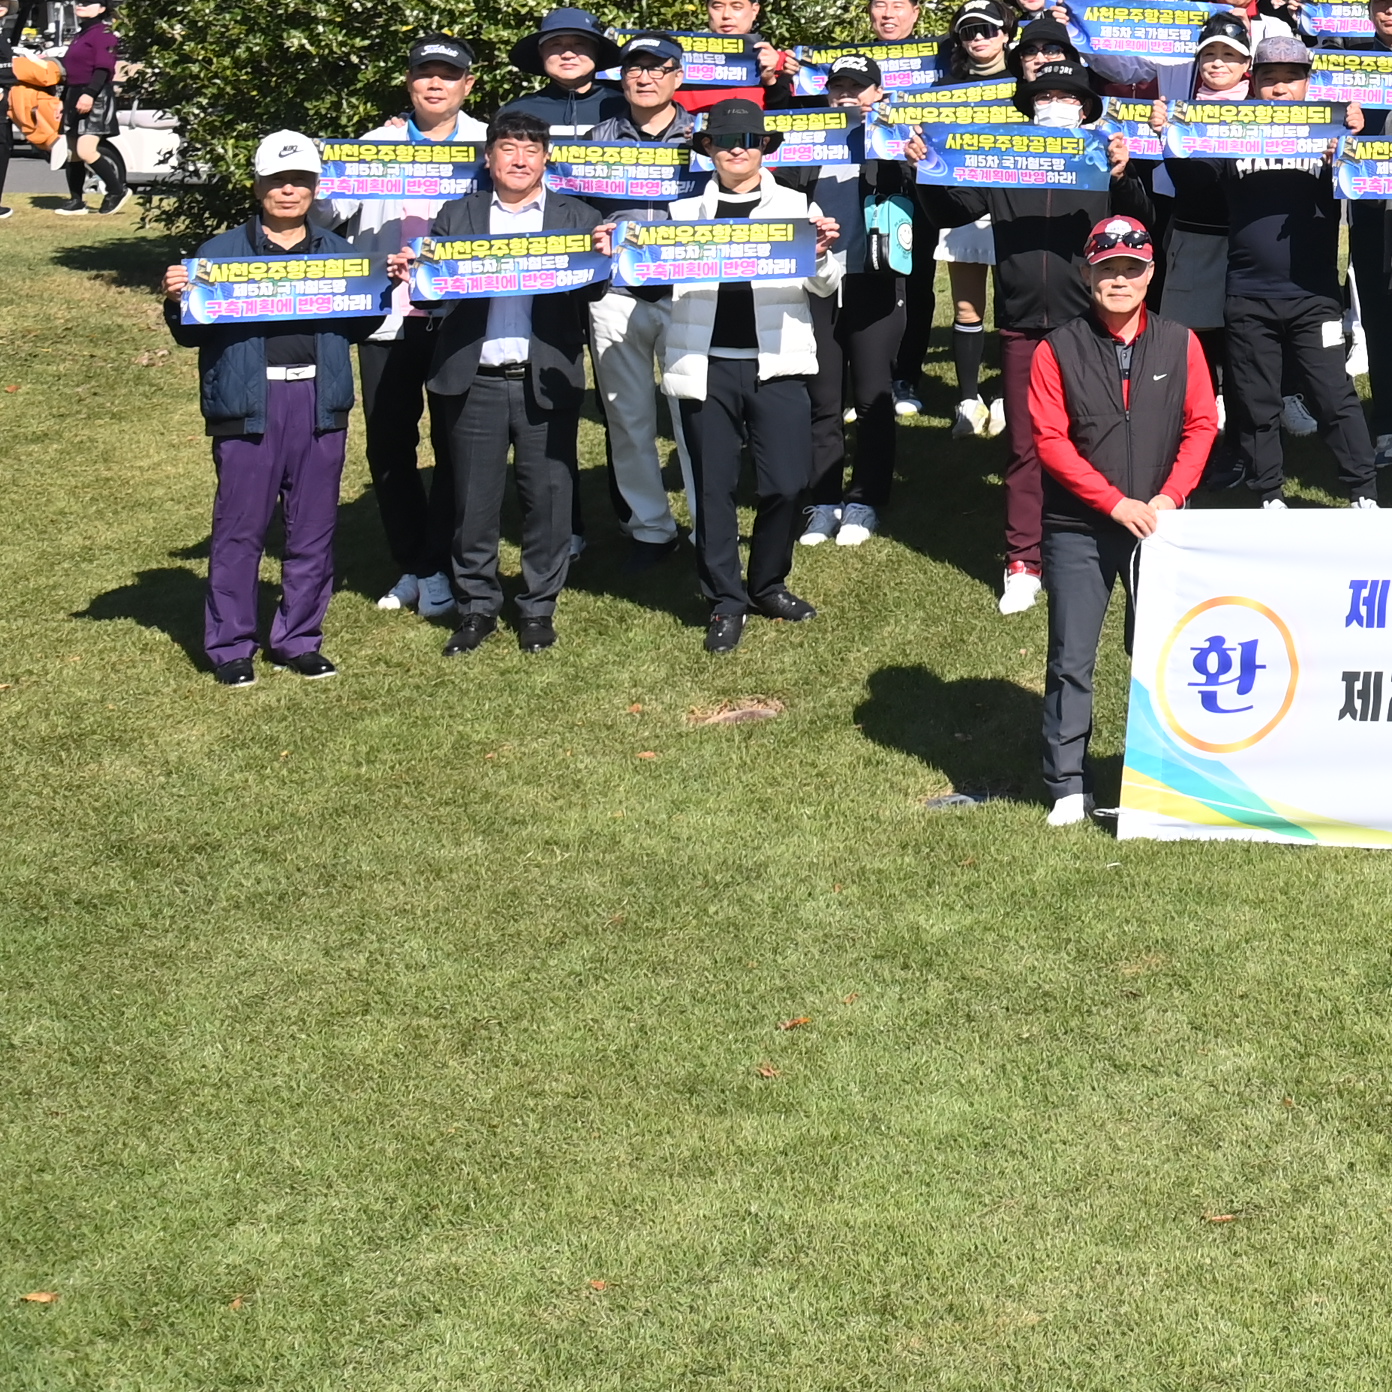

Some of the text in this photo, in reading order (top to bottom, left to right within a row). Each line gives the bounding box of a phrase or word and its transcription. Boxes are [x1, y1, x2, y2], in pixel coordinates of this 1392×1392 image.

[1100, 26, 1132, 38] 제5차
[687, 65, 746, 82] 반영하라!
[1331, 71, 1366, 85] 제5차
[1308, 85, 1382, 103] 구축계획에
[1185, 104, 1331, 123] 사천우주항공철도!
[1206, 123, 1309, 136] 제5차 국가철도망
[943, 133, 1085, 154] 사천우주항공철도!
[1182, 137, 1260, 154] 구축계획에
[322, 143, 475, 163] 사천우주항공철도!
[783, 144, 849, 161] 반영하라!
[344, 162, 453, 176] 제5차 국가철도망
[571, 163, 674, 178] 제5차 국가철도망
[963, 154, 1066, 170] 제5차 국가철도망
[952, 167, 1077, 184] 구축계획에 반영하라!
[319, 177, 402, 194] 구축계획에
[547, 177, 625, 194] 구축계획에
[637, 223, 793, 244] 사천우주항공철도!
[434, 235, 591, 259] 사천우주항공철도!
[660, 243, 771, 259] 제5차 국가철도망
[209, 259, 369, 281] 사천우주항공철도!
[457, 254, 569, 273] 제5차 국가철도망
[634, 257, 796, 279] 구축계획에 반영하라!
[232, 278, 346, 296] 제5차 국가철도망
[432, 268, 595, 294] 구축계획에 반영하라!
[205, 293, 372, 318] 구축계획에 반영하라!
[1187, 633, 1267, 714] 환
